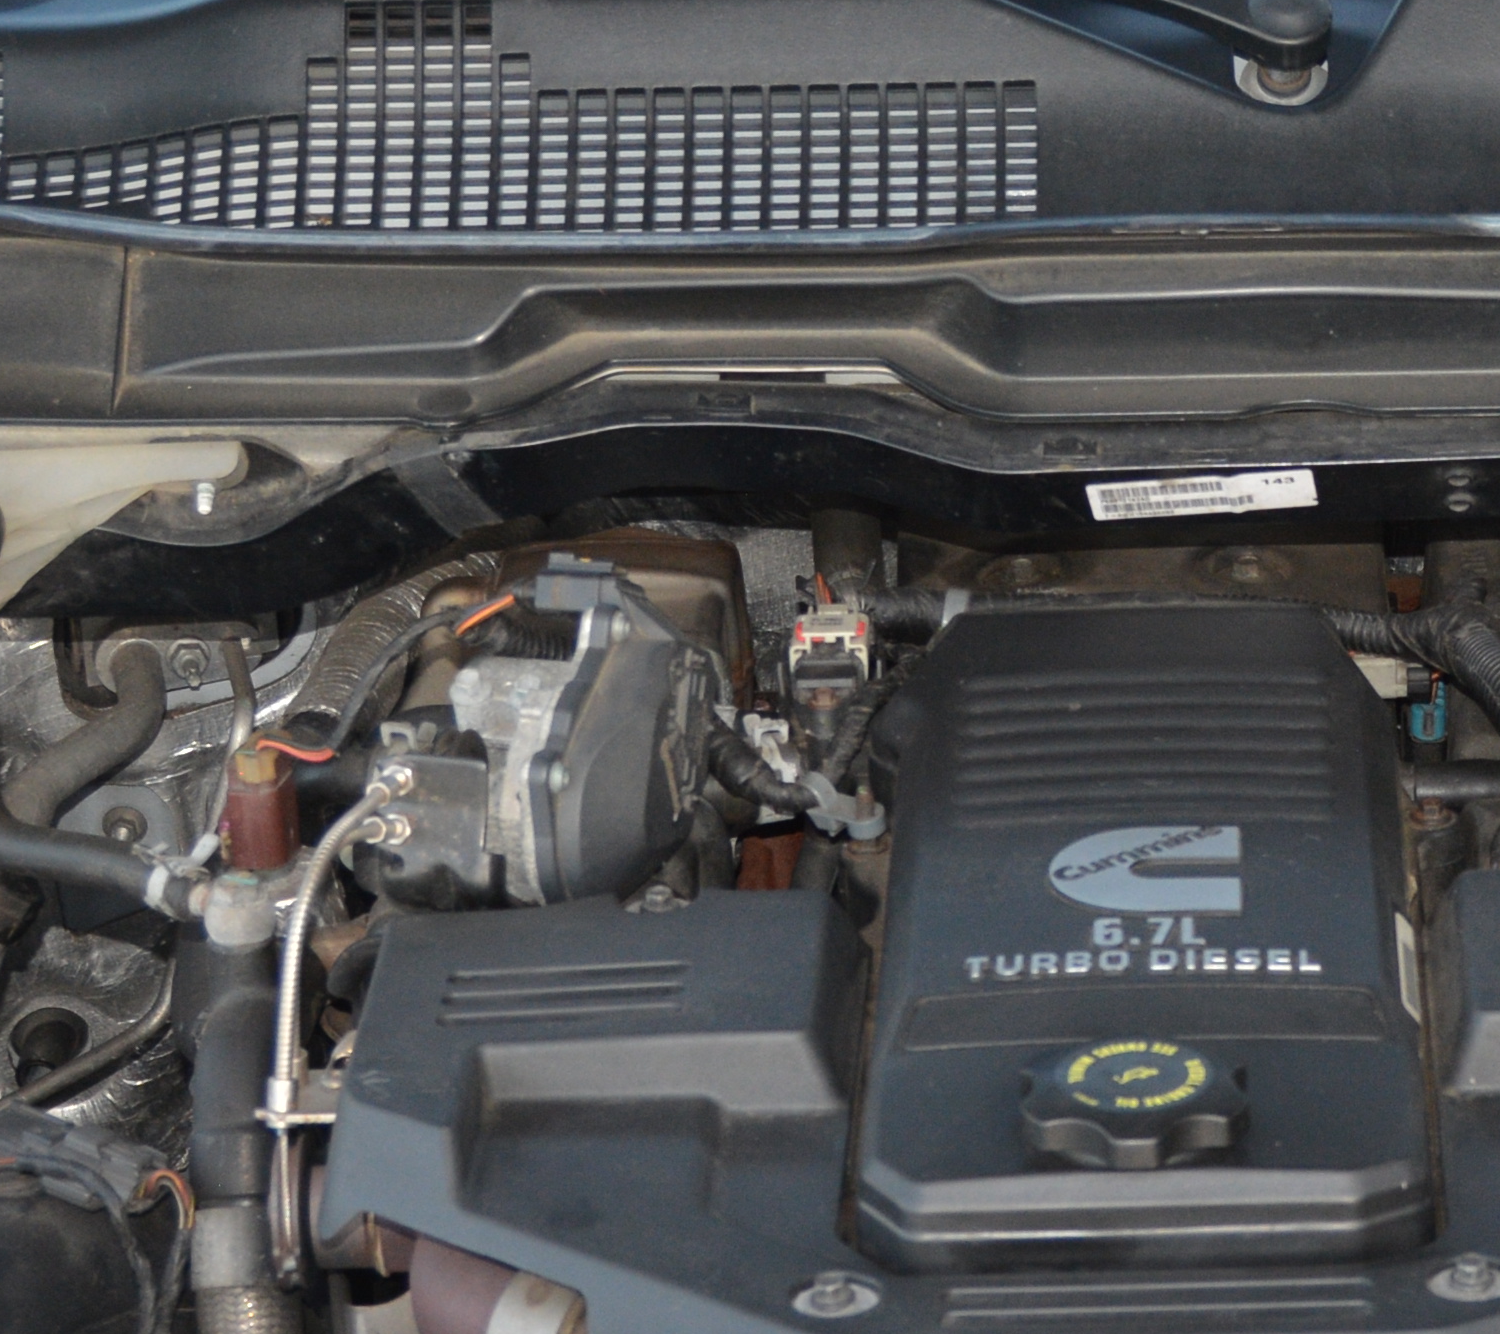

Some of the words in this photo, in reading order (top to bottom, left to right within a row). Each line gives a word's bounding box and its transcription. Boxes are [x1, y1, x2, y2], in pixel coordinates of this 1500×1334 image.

[1261, 476, 1296, 486] 143
[1052, 825, 1224, 883] Cummins
[1092, 916, 1207, 947] 6.7L
[965, 950, 1131, 980] TURBO
[1148, 948, 1323, 973] DIESEL
